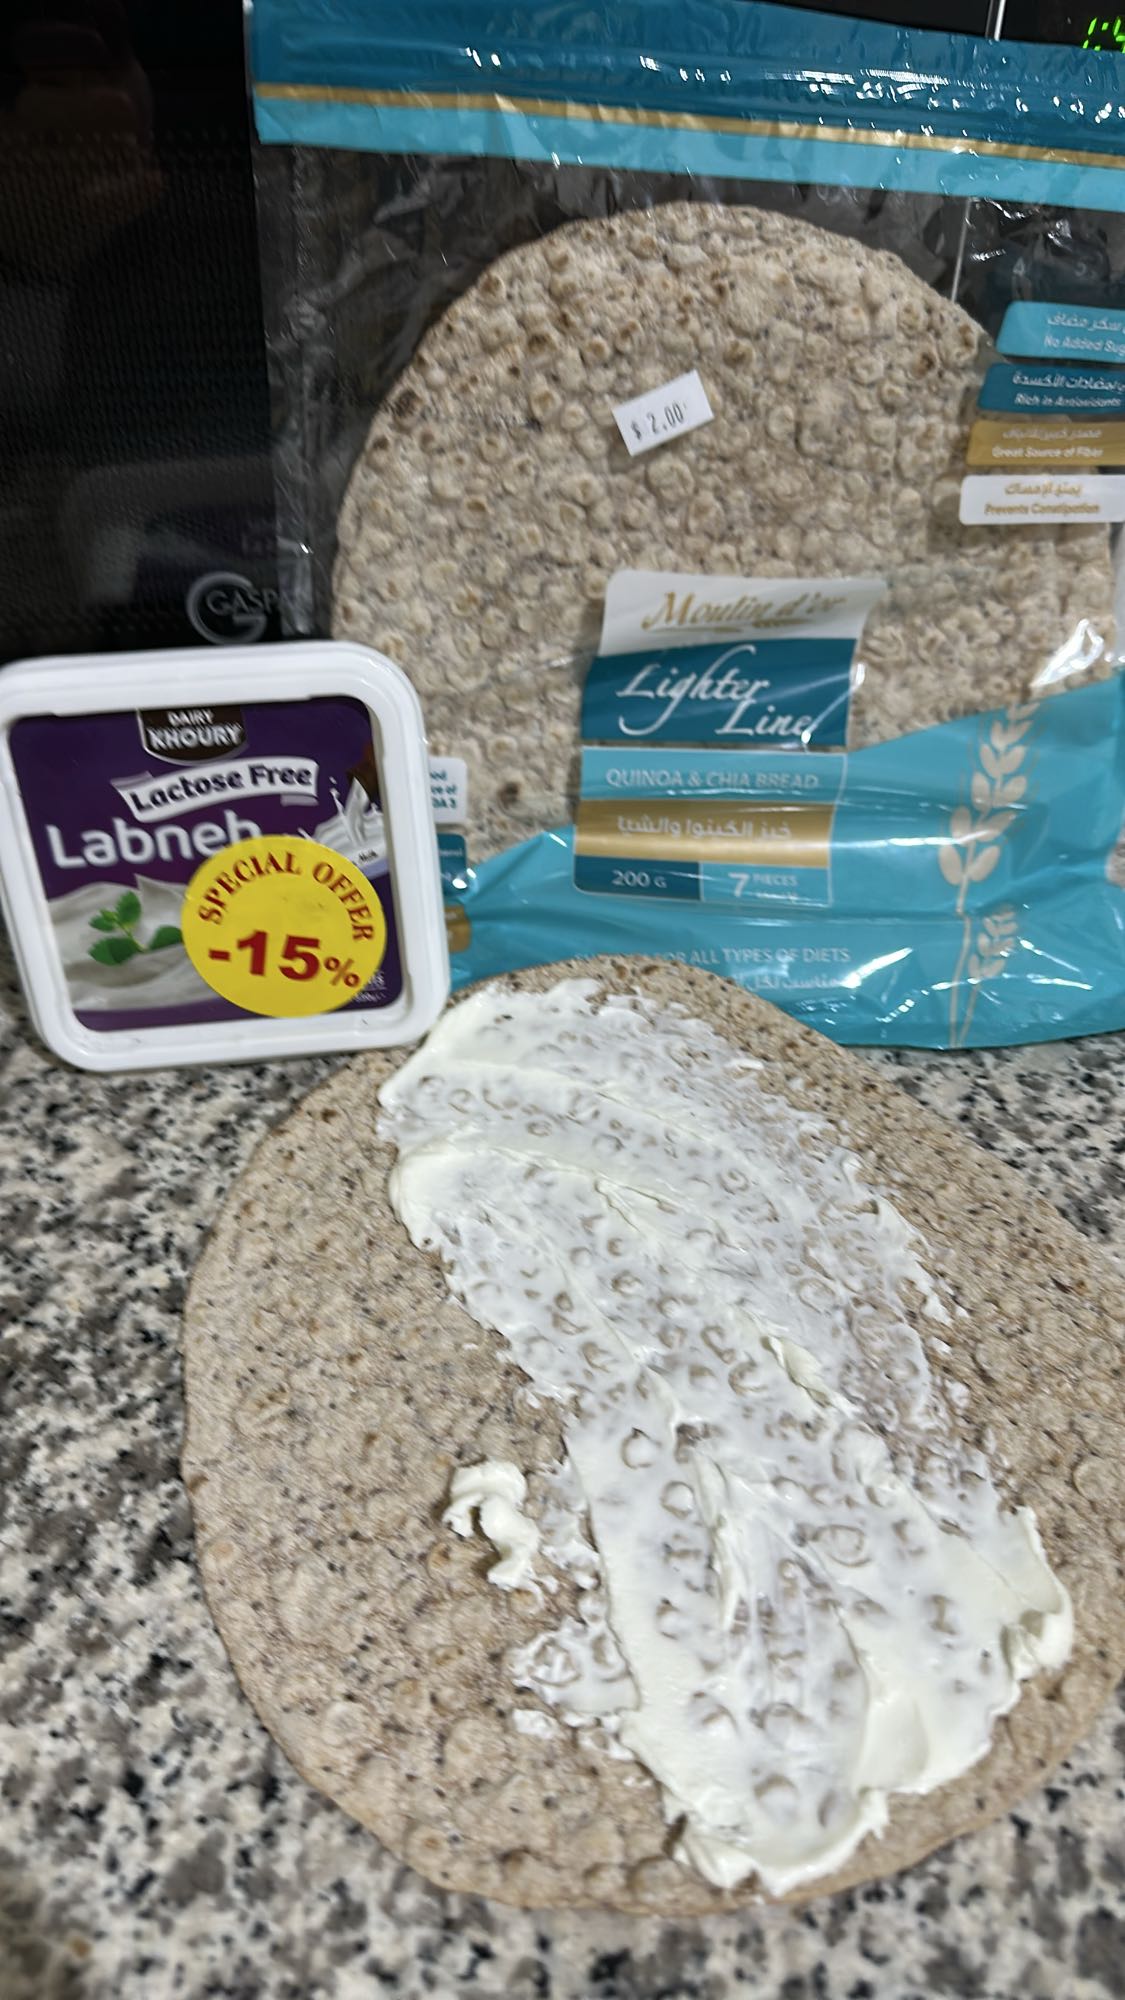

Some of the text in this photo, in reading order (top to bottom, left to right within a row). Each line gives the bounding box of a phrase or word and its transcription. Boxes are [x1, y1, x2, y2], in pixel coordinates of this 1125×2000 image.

[1044, 334, 1060, 348] No
[1062, 336, 1103, 351] Added
[1014, 393, 1040, 406] Rich
[1042, 395, 1053, 405] in
[631, 421, 641, 441] $
[992, 446, 1024, 458] Great
[1025, 446, 1061, 458] Source
[984, 503, 1100, 516] Prevents Constipation
[616, 644, 770, 736] Lighter
[166, 708, 215, 726] DAIRY
[715, 700, 816, 738] Line
[147, 723, 243, 750] KHOURY
[130, 764, 313, 812] Lactose Free
[606, 768, 819, 790] QUINOA & CHIA BREAD
[45, 809, 263, 869] Labneh
[757, 819, 793, 841] خبز
[611, 869, 667, 888] 200 G
[728, 871, 750, 897] 7
[751, 873, 799, 887] PIECES
[198, 852, 375, 941] SPECIAL OFFER
[208, 929, 361, 988] -15%
[690, 950, 719, 964] ALL
[721, 947, 773, 962] TYPES
[802, 947, 851, 962] DIETS
